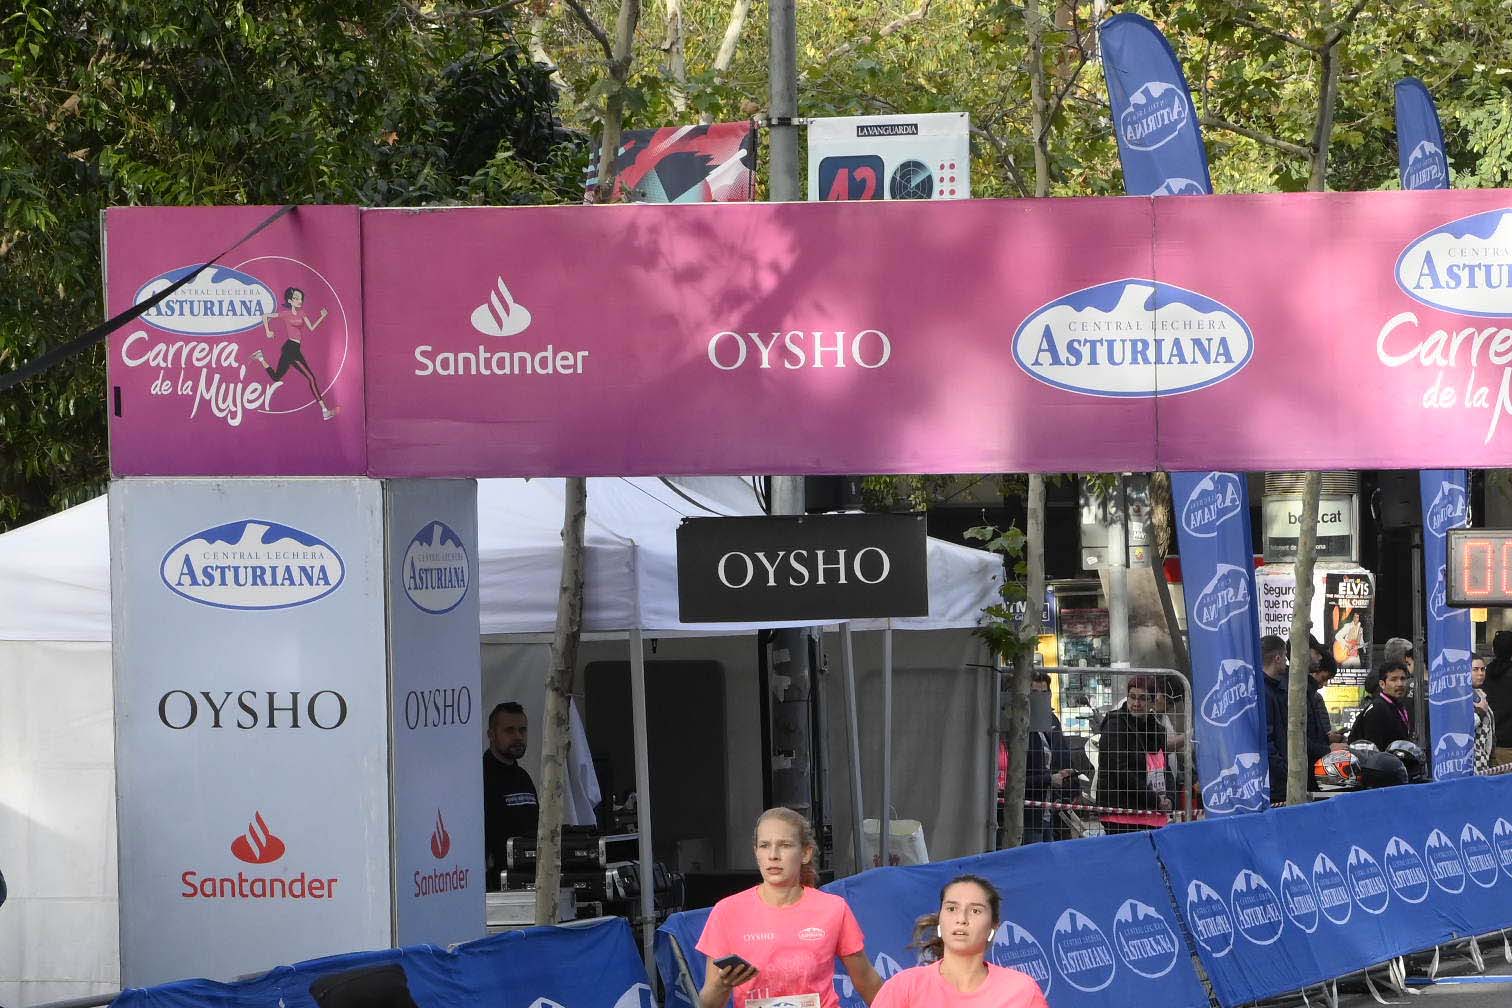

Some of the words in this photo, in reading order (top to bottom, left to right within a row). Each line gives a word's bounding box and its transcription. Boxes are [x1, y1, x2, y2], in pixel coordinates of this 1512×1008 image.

[146, 289, 265, 317] ASTURIANA
[173, 288, 212, 297] ENTRAL
[1068, 320, 1143, 332] CENTRAL
[1151, 319, 1227, 331] LECHERA
[121, 331, 239, 368] Carrera
[414, 344, 589, 376] Santander
[708, 329, 891, 370] OYSHO
[1031, 323, 1235, 367] ASTURIANA
[151, 371, 173, 396] de
[178, 363, 193, 396] la
[190, 365, 284, 427] Mujer
[1423, 371, 1457, 408] de
[1464, 370, 1489, 408] la
[1288, 510, 1342, 525] bc.cat
[175, 553, 332, 587] ASTURIANA
[202, 551, 262, 560] CENTRAL
[266, 551, 325, 560] LECHERA
[718, 546, 891, 590] OYSHO
[408, 555, 466, 592] ASTURIANA
[1338, 583, 1370, 596] ELVIS
[158, 690, 348, 730] OYSHO
[405, 686, 472, 731] OYSHO
[181, 871, 339, 899] Santander
[414, 866, 469, 898] Santander
[1058, 942, 1112, 974] ASTURIANA
